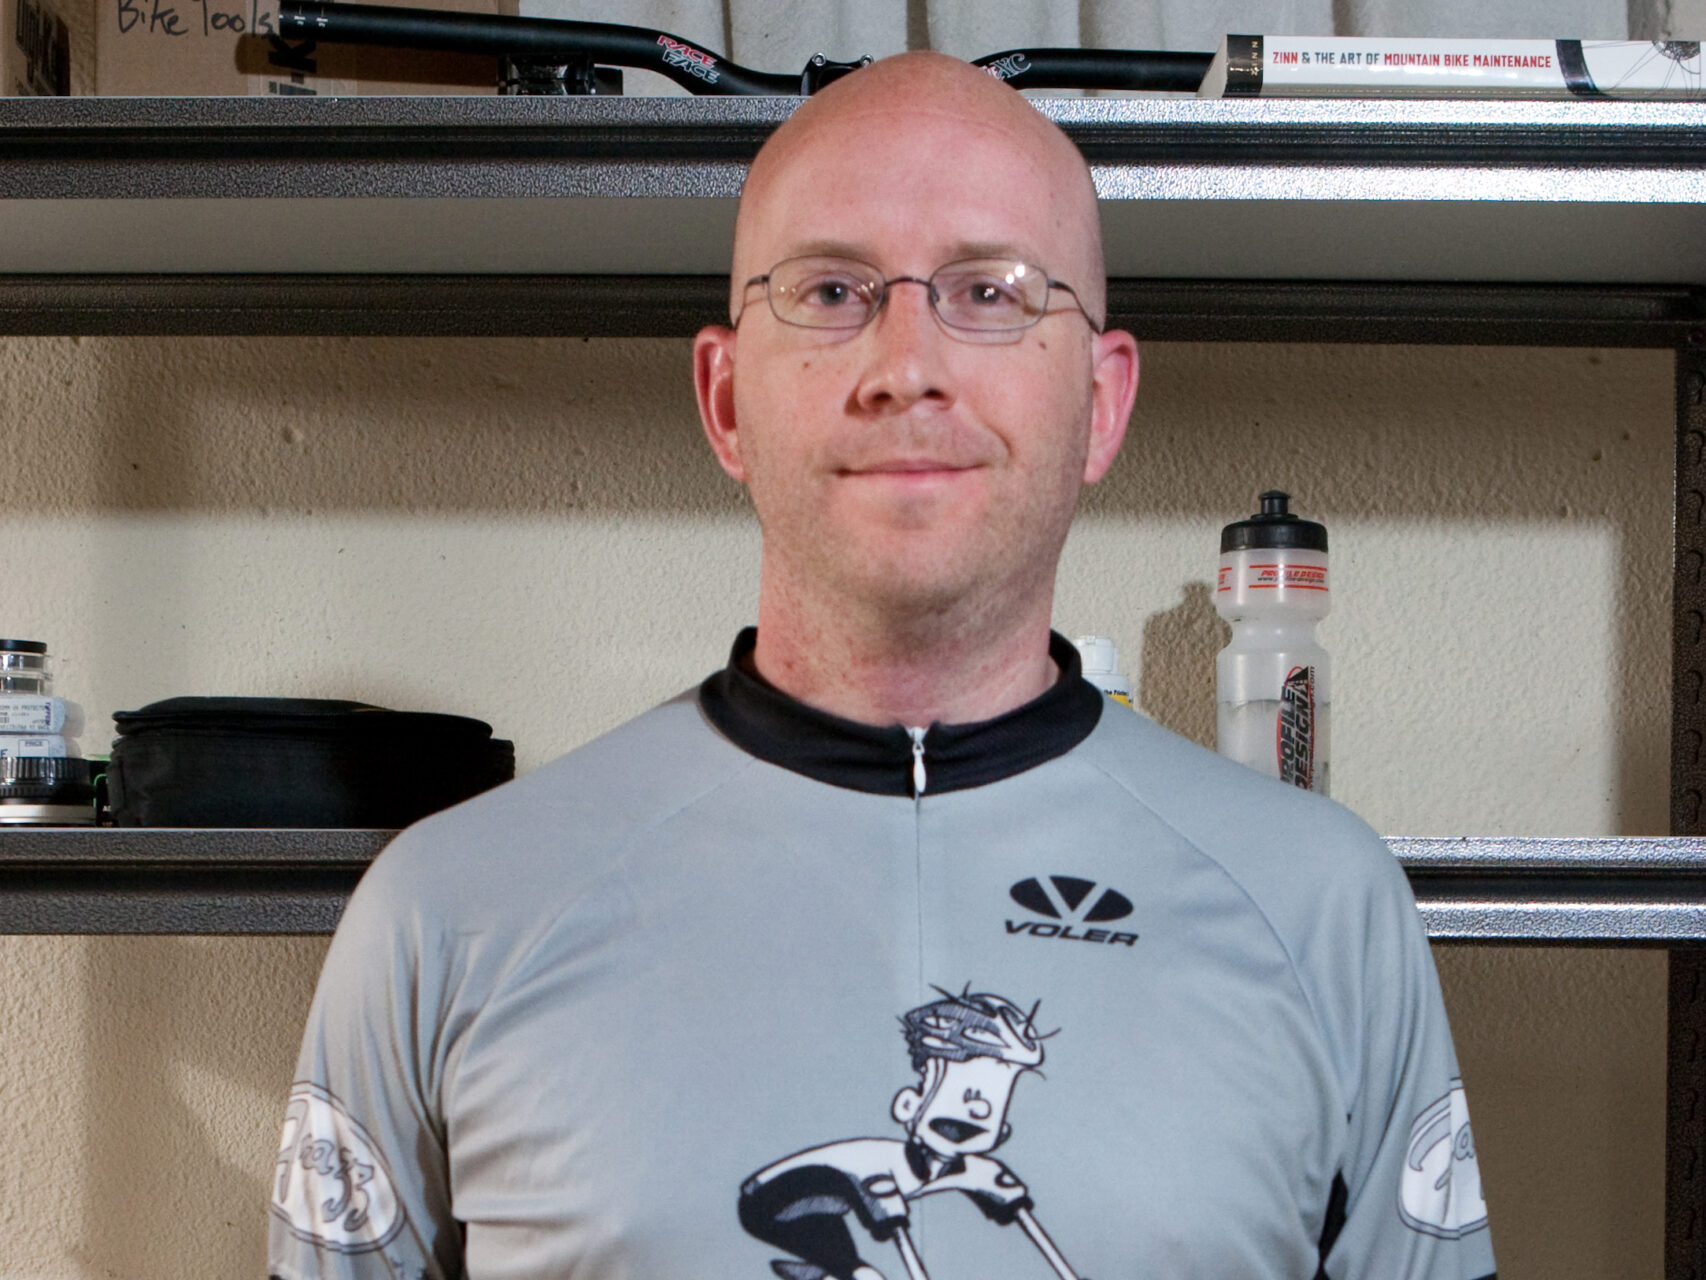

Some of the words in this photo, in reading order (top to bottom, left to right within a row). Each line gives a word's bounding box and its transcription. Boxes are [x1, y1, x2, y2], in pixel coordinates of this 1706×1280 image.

[117, 0, 189, 35] Bike
[195, 0, 276, 36] Tools
[656, 34, 718, 69] RACE
[662, 50, 720, 84] FACE
[1272, 51, 1298, 64] ZINN
[1301, 51, 1311, 64] &
[1315, 52, 1335, 64] THE
[1339, 52, 1362, 65] ART
[1365, 52, 1380, 65] OF
[1384, 53, 1440, 66] MOUNTAIN
[1444, 54, 1469, 67] BIKE
[1473, 54, 1552, 68] MAINTENANCE
[1005, 919, 1139, 946] VOLER
